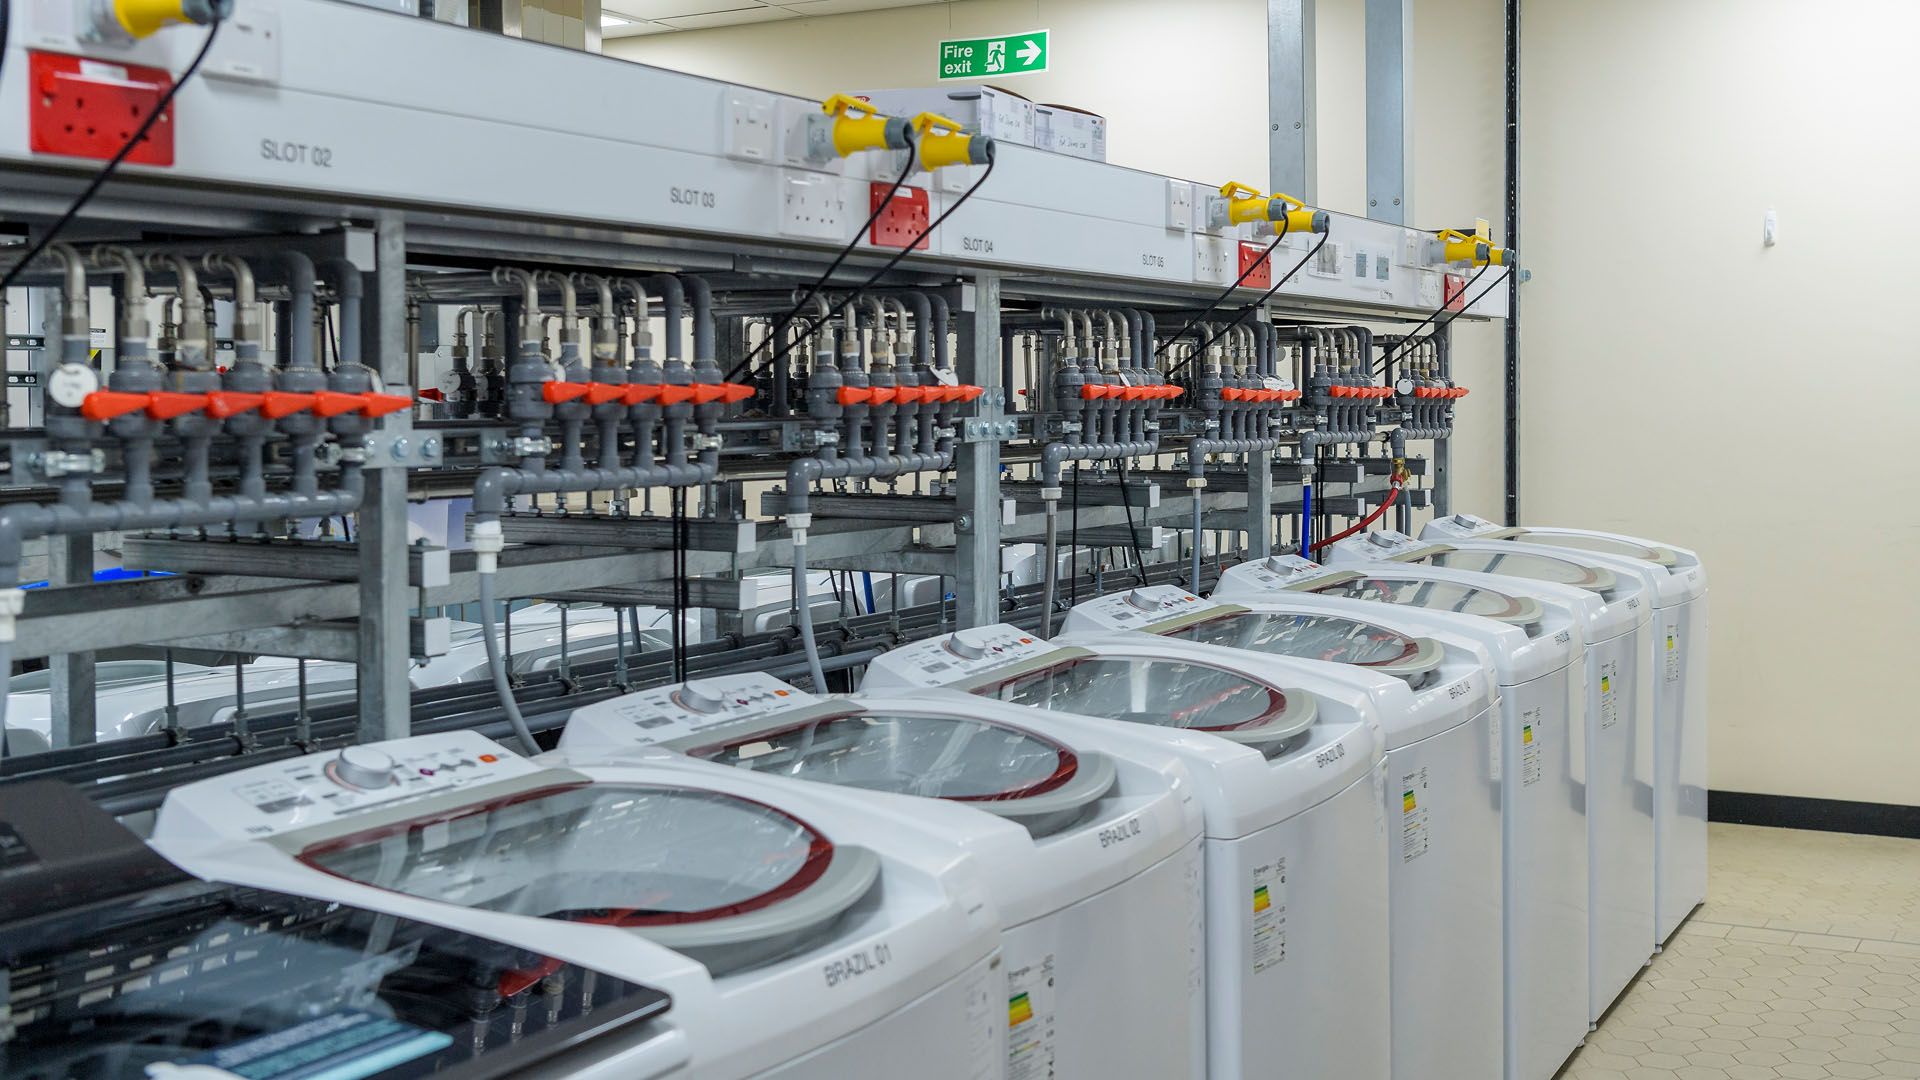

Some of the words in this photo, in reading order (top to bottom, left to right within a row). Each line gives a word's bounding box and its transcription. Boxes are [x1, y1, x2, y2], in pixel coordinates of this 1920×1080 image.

[944, 46, 973, 58] Fire
[944, 61, 972, 74] exit
[261, 138, 309, 164] SLOT
[311, 146, 333, 168] 02
[670, 187, 700, 205] SLOT
[703, 192, 715, 209] 03
[963, 236, 983, 251] SLOT
[985, 240, 993, 253] 04
[1142, 254, 1157, 266] SLOT
[1449, 683, 1466, 699] BRAZIL
[1316, 749, 1338, 768] BRAZIL
[1336, 743, 1345, 757] 03
[1099, 824, 1131, 848] BRAZIL
[1129, 818, 1141, 836] 02
[824, 952, 876, 988] BRAZIL
[874, 944, 892, 965] 01
